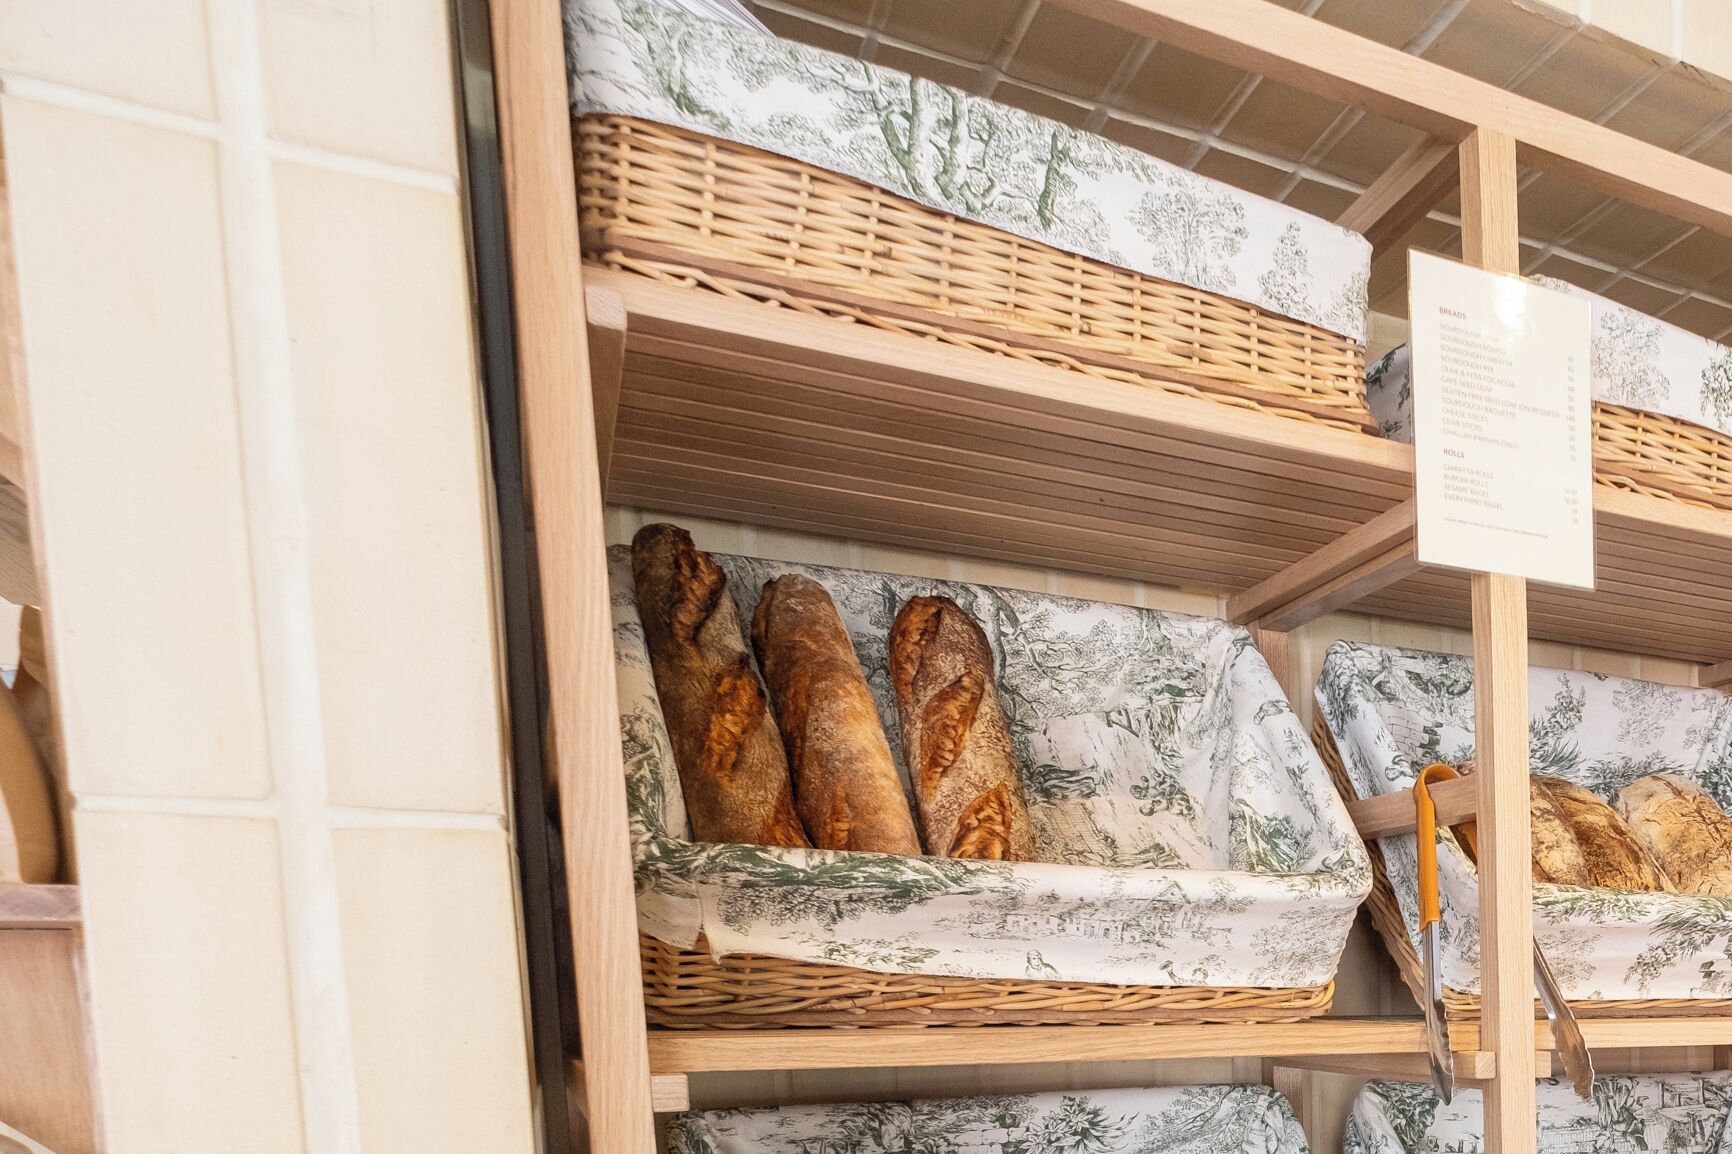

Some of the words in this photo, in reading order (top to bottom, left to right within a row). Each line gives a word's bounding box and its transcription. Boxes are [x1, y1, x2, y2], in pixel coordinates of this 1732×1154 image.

[1439, 307, 1466, 320] BREADS
[1440, 323, 1481, 339] SOURDOUGH
[1440, 334, 1482, 349] SOURDOUGH
[1482, 344, 1506, 355] ROUND
[1440, 344, 1481, 360] SOURDOUGH
[1483, 355, 1514, 368] CIABATTA
[1441, 354, 1481, 370] SOURDOUGH
[1483, 365, 1494, 373] RYE
[1441, 365, 1457, 375] OLIVE
[1467, 371, 1482, 381] FETA
[1484, 375, 1516, 389] FOCACCIA
[1441, 376, 1458, 385] CAPE
[1459, 380, 1475, 389] SEED
[1476, 384, 1492, 393] LOAF
[1441, 386, 1467, 398] GLUTEN
[1468, 392, 1482, 401] FREE
[1484, 396, 1500, 405] SEED
[1502, 400, 1517, 409] LOAF
[1519, 404, 1530, 412] (ON
[1532, 407, 1560, 419] REQUEST)
[1441, 396, 1483, 412] SOURDOUGH
[1484, 406, 1515, 419] BAGUETTE
[1442, 407, 1465, 418] CHEESE
[1467, 412, 1488, 423] STICKS
[1442, 417, 1460, 427] OLIVE
[1462, 422, 1483, 432] STICKS
[1442, 428, 1472, 440] CHALLAH
[1444, 448, 1464, 458] ROLLS
[1443, 463, 1474, 476] CIABATTA
[1475, 470, 1495, 480] ROLLS
[1444, 473, 1469, 484] BURGER
[1470, 478, 1488, 488] ROLLS
[1444, 484, 1468, 494] SESAME
[1470, 489, 1489, 498] BAGEL
[1444, 493, 1482, 506] EVERYTHING
[1484, 500, 1503, 510] BAGEL
